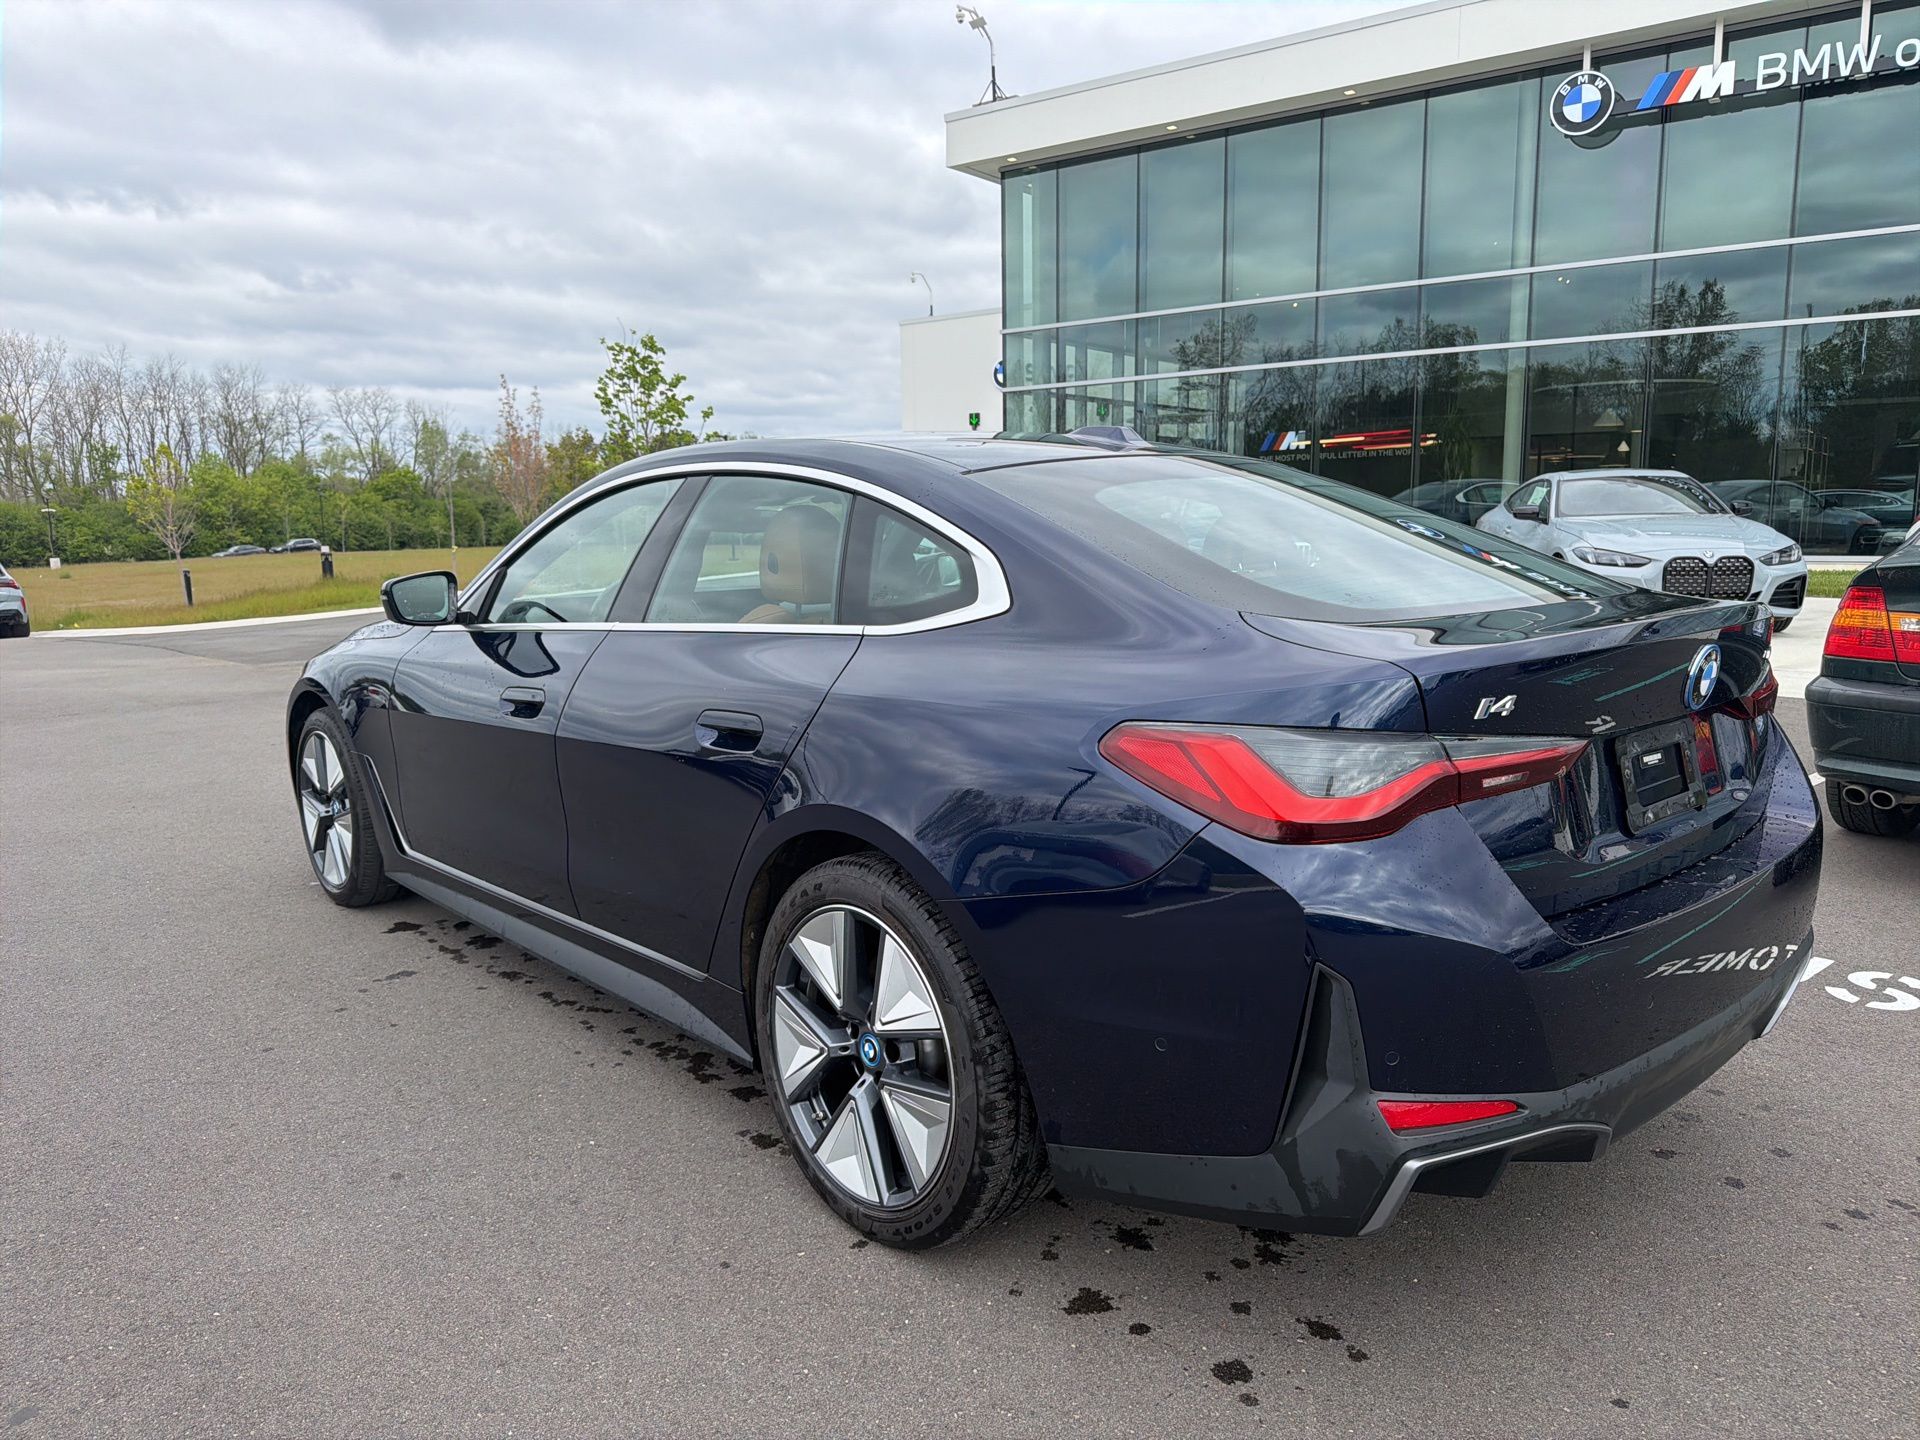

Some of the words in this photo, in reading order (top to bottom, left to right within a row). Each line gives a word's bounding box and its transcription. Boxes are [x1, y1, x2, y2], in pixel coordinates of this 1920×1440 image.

[1756, 34, 1881, 91] BMW
[1559, 74, 1607, 96] BMW
[1275, 453, 1296, 462] MOST
[1296, 451, 1337, 462] POWRFUL
[1338, 449, 1367, 459] LETTER
[1368, 449, 1377, 457] IN
[1379, 448, 1394, 457] THE
[1473, 694, 1517, 720] i4
